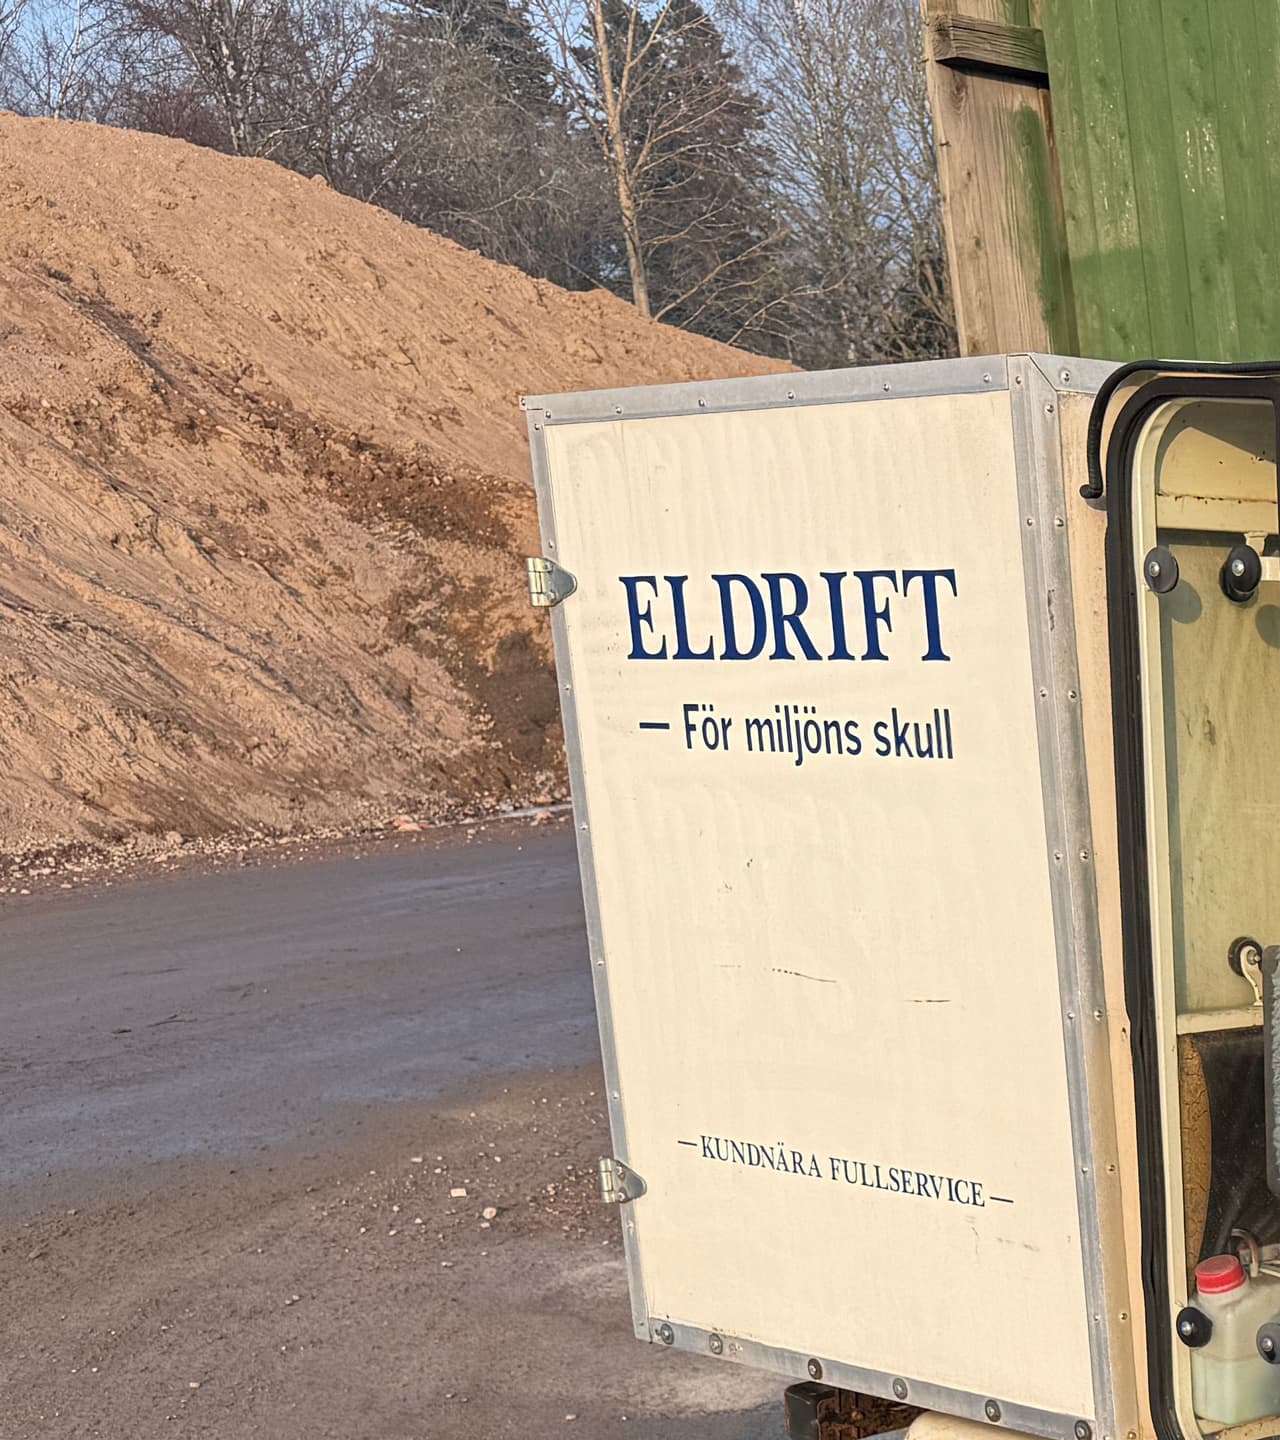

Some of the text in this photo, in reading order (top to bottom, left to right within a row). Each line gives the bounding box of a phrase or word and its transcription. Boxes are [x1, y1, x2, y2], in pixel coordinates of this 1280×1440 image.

[619, 569, 957, 661] ELDRIFT
[683, 703, 732, 750] För
[745, 704, 862, 767] miljöns
[873, 707, 953, 760] skull
